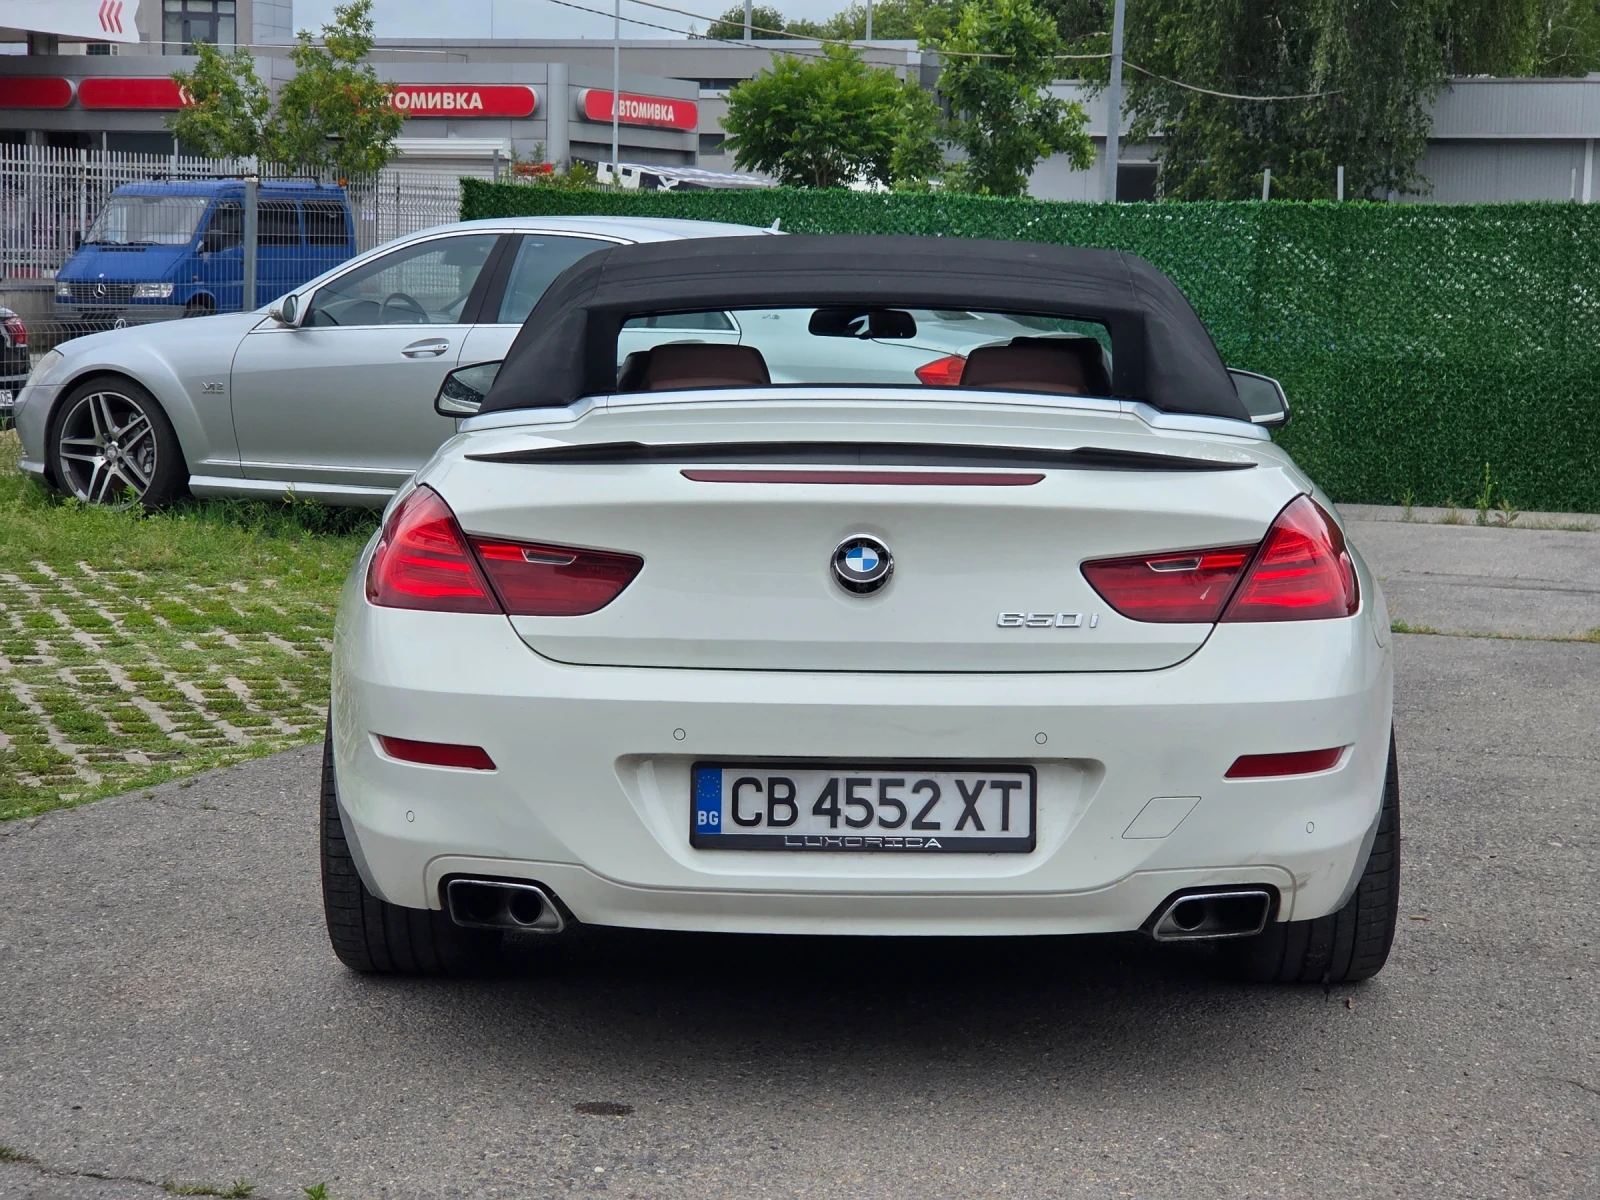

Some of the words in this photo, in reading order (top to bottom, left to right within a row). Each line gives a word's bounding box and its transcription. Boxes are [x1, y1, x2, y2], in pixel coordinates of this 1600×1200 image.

[997, 612, 1099, 628] 650i
[731, 776, 799, 828] CB
[811, 777, 942, 830] 4552
[953, 779, 1023, 832] XT
[697, 810, 719, 826] BG
[784, 835, 943, 848] LUXORICA
